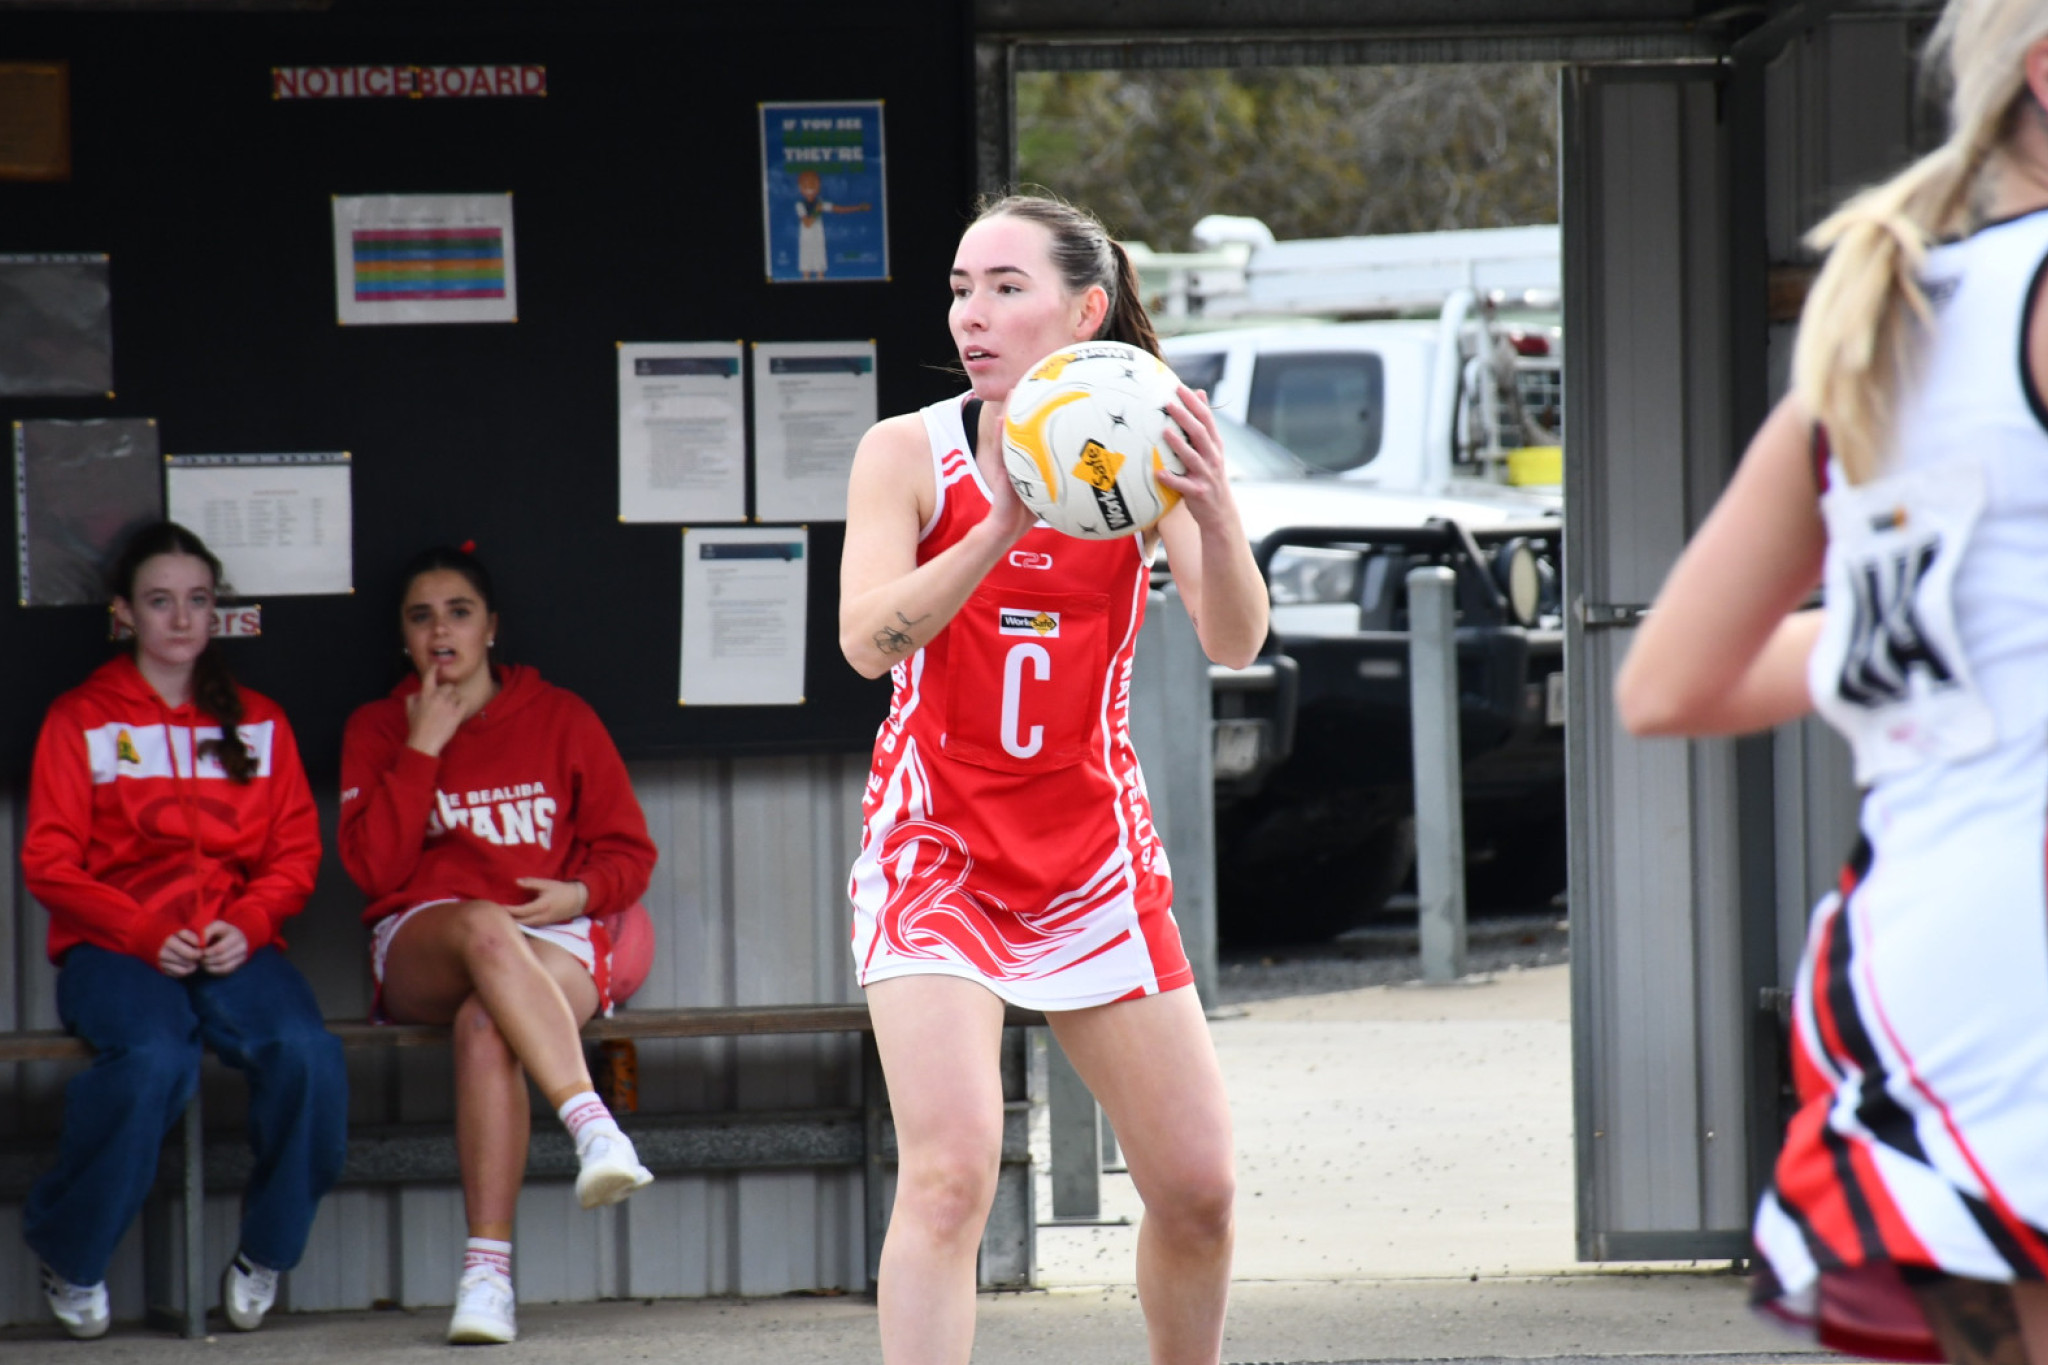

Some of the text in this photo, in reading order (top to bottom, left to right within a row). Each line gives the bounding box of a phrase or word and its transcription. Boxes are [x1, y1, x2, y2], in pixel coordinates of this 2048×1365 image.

[274, 66, 546, 98] NOTICE BOARD
[1001, 642, 1050, 759] C
[466, 781, 545, 805] BEALIBA
